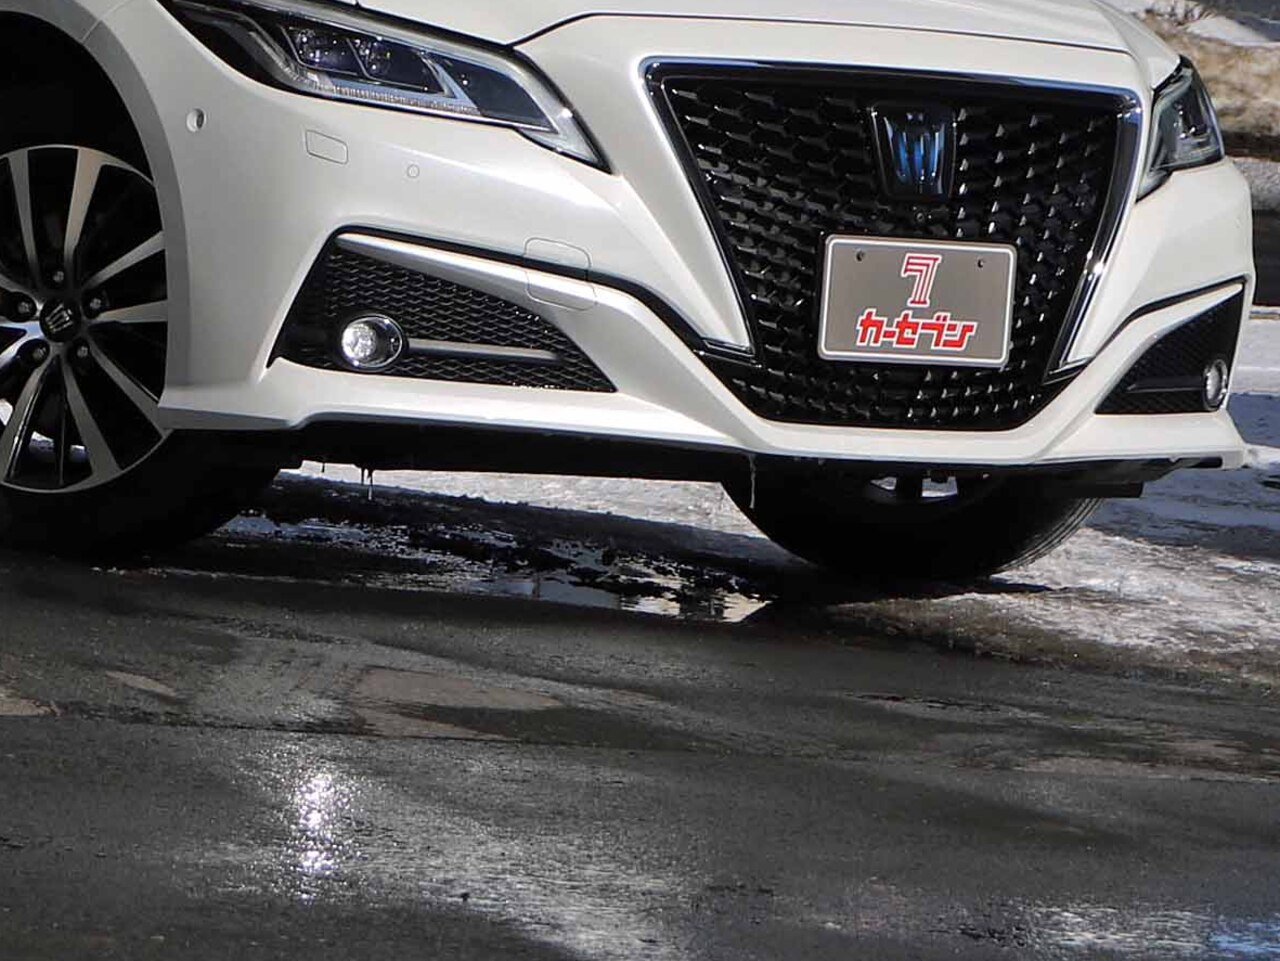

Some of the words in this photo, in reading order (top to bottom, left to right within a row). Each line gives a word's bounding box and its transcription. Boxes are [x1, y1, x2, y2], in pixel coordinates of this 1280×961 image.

[856, 308, 977, 350] カーセブン
